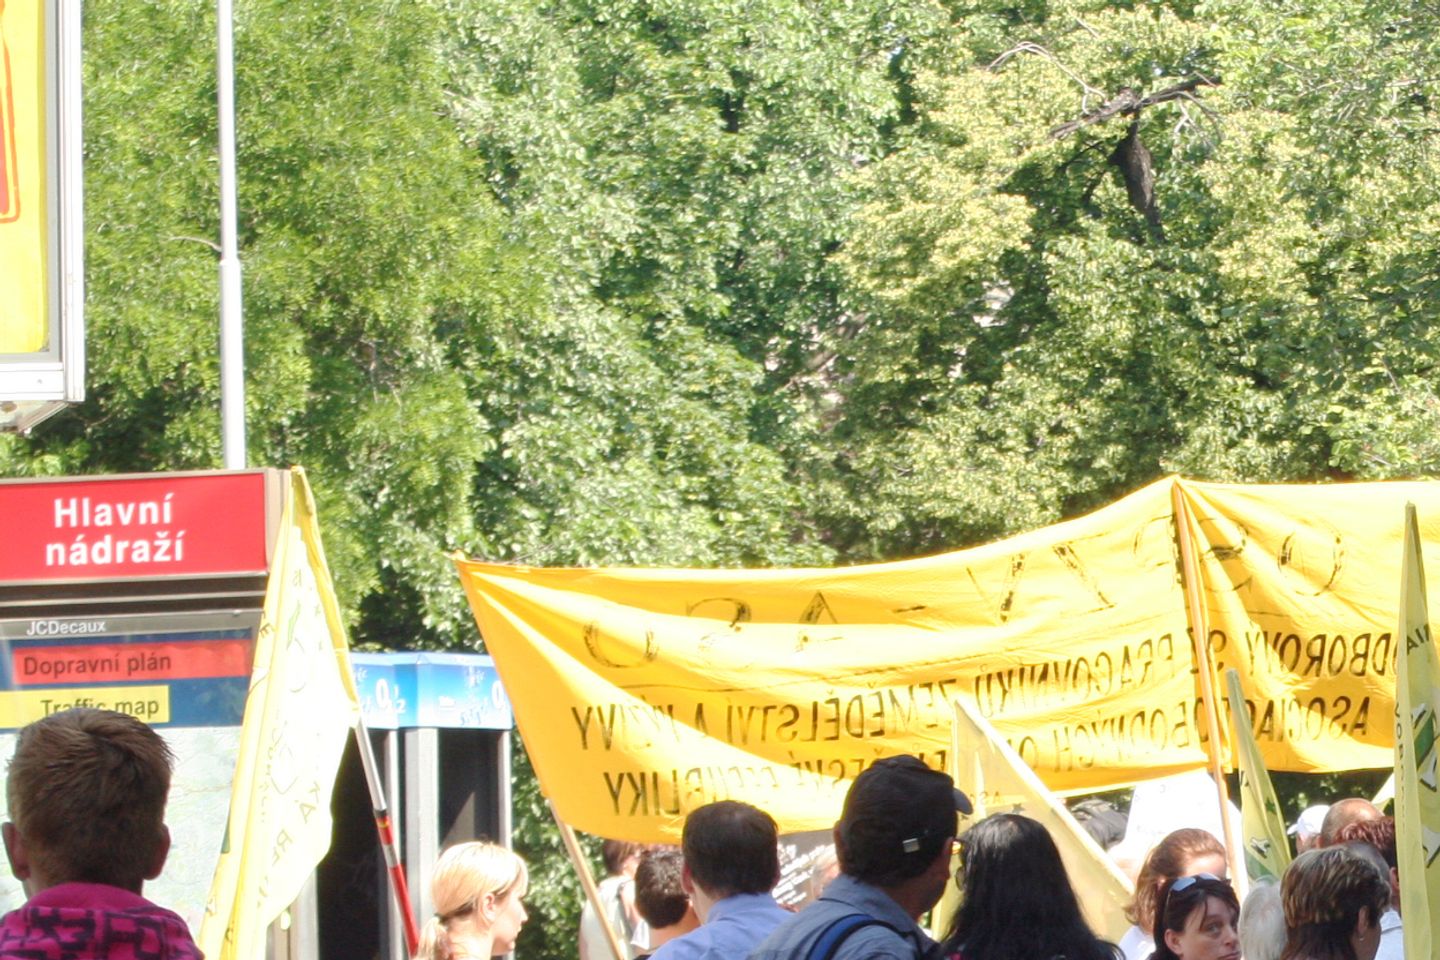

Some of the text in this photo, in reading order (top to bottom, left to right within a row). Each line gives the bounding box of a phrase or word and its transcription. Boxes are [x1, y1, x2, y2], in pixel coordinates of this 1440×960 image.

[54, 492, 174, 529] Hlavní
[46, 530, 186, 567] nádraží
[26, 620, 107, 636] JCDecaux
[24, 652, 171, 680] Dopravní plán
[115, 701, 159, 719] map
